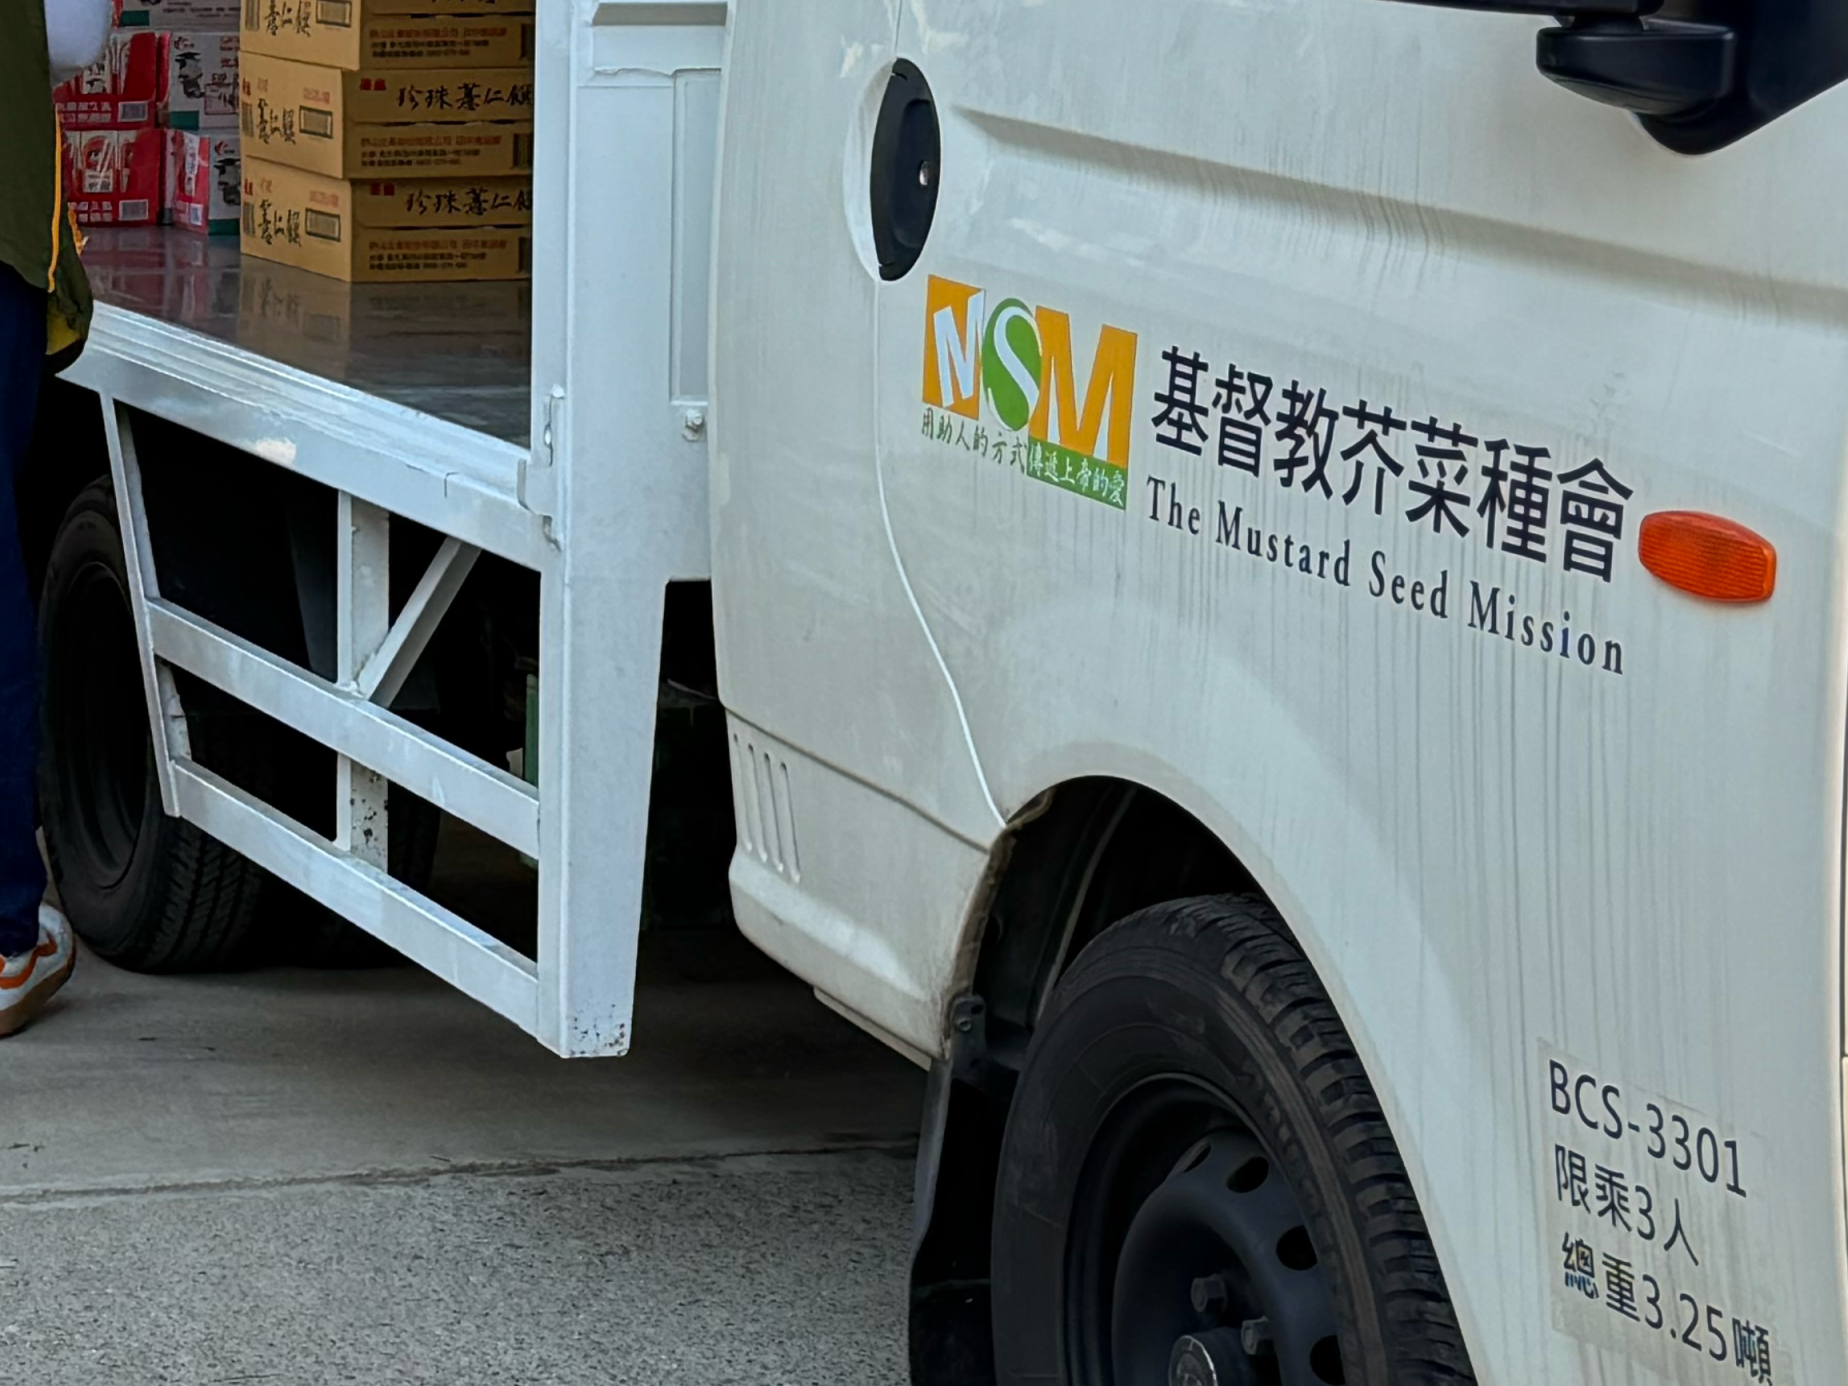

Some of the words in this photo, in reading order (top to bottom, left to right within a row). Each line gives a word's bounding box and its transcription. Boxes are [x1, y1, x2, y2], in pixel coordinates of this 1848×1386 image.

[921, 408, 1029, 475] 用助人的方式
[922, 274, 1138, 471] NSM
[1152, 345, 1634, 583] 基督教芥菜種會
[1147, 475, 1201, 535] The
[1215, 500, 1351, 587] Mustard
[1368, 550, 1449, 619] Seed
[1468, 580, 1623, 675] Mission
[1549, 1058, 1747, 1198] BCS-3301
[1555, 1143, 1699, 1266] 限乘3人
[1562, 1231, 1773, 1386] 總重3.25噸
